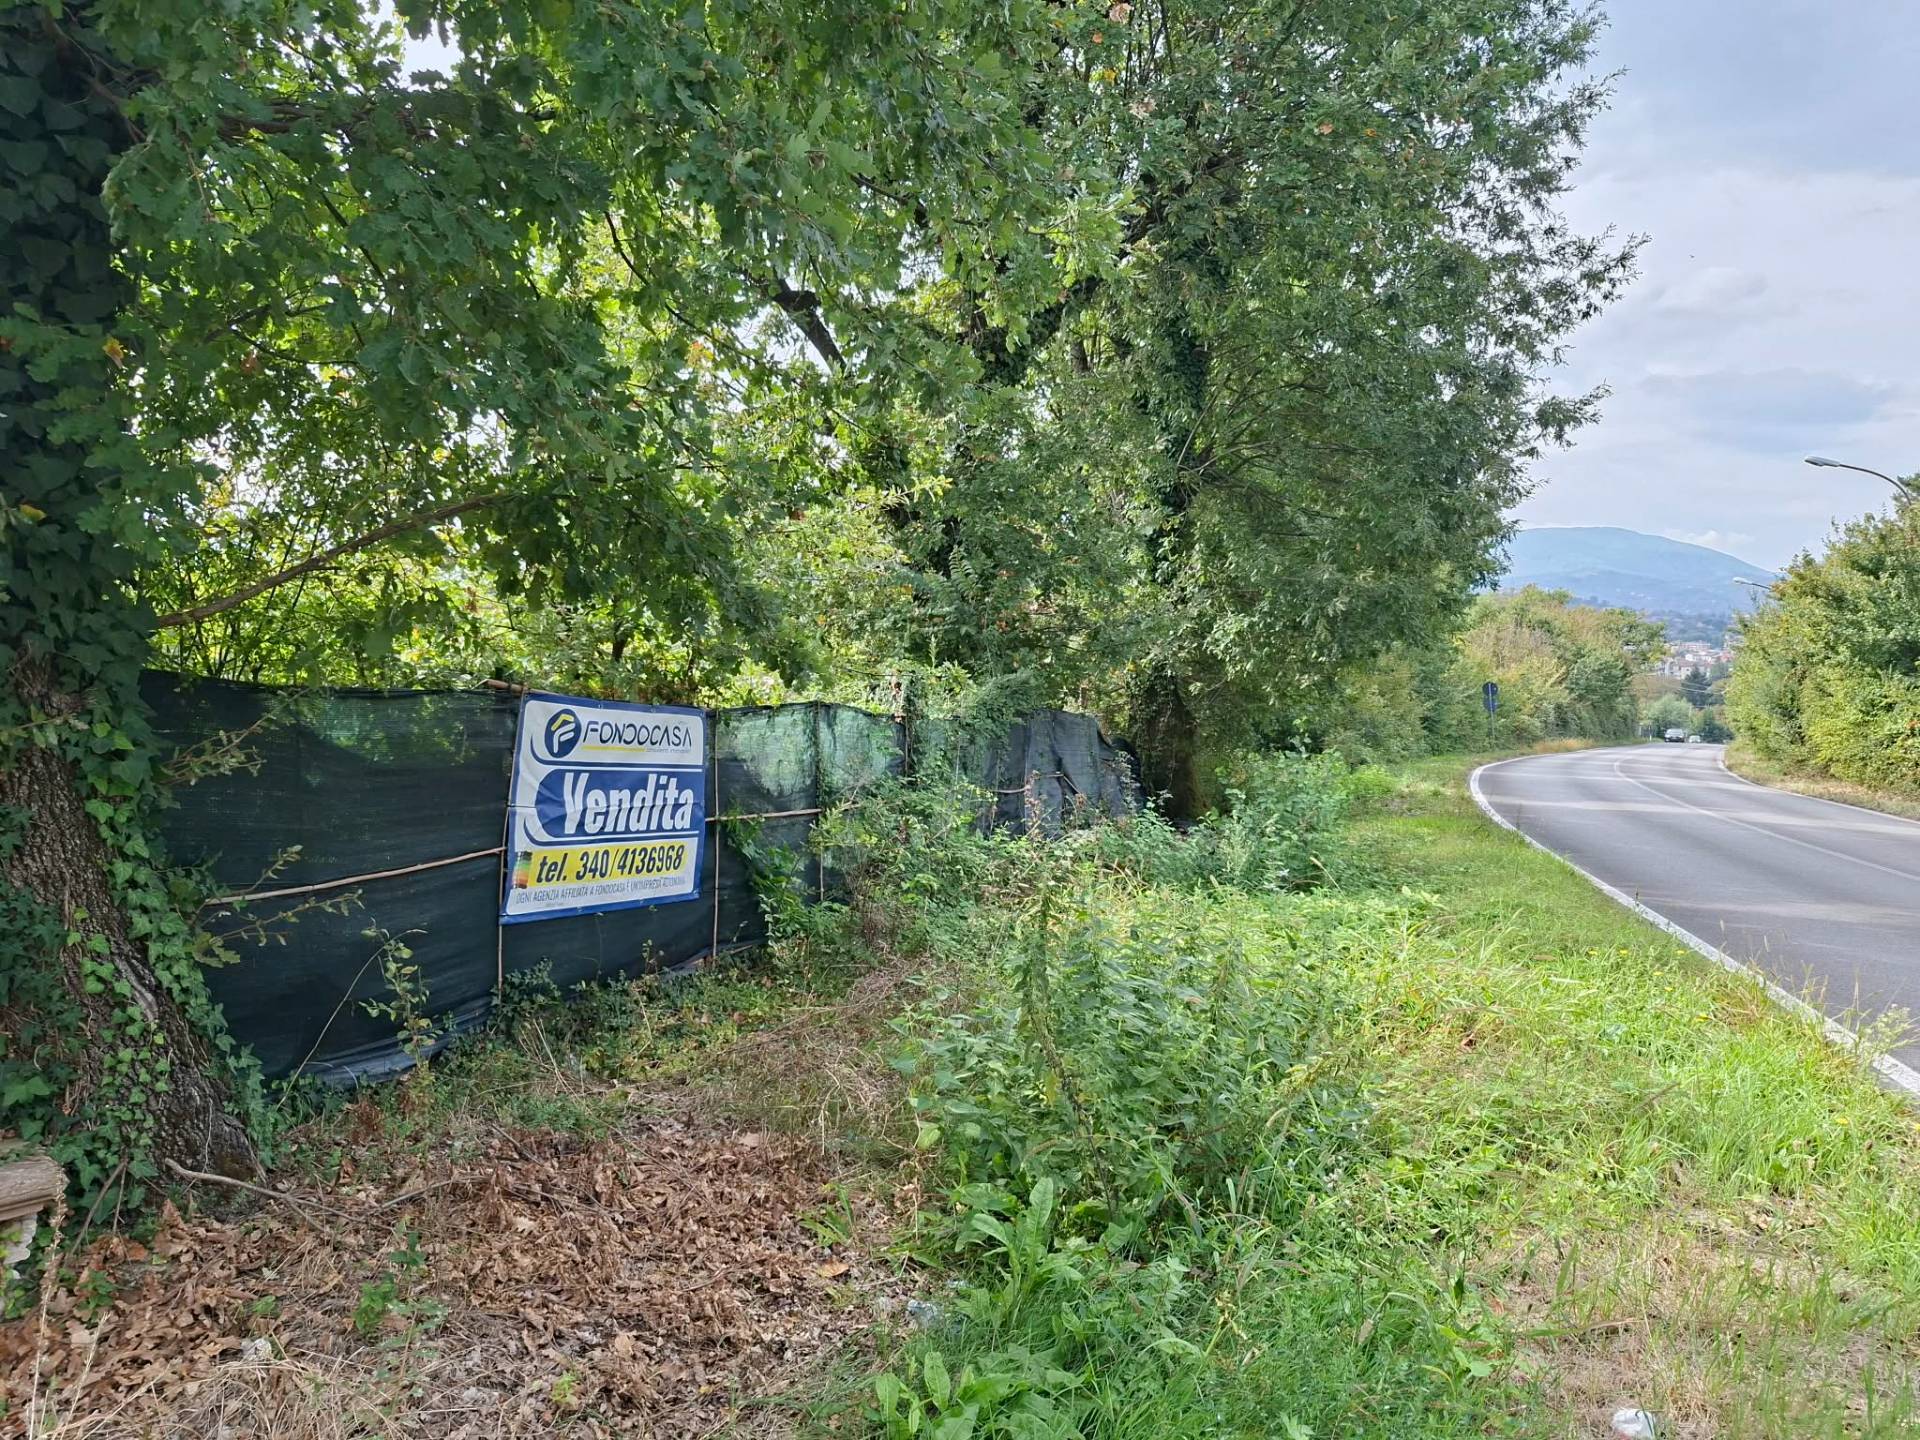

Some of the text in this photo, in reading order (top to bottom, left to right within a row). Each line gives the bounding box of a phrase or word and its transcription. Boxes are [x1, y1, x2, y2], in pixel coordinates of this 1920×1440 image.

[582, 720, 692, 748] FONDOCASA
[563, 772, 694, 834] Vendita
[536, 844, 685, 884] tel. 340/4136968
[533, 889, 559, 902] AGENZIA
[560, 887, 588, 899] AFFILIATA
